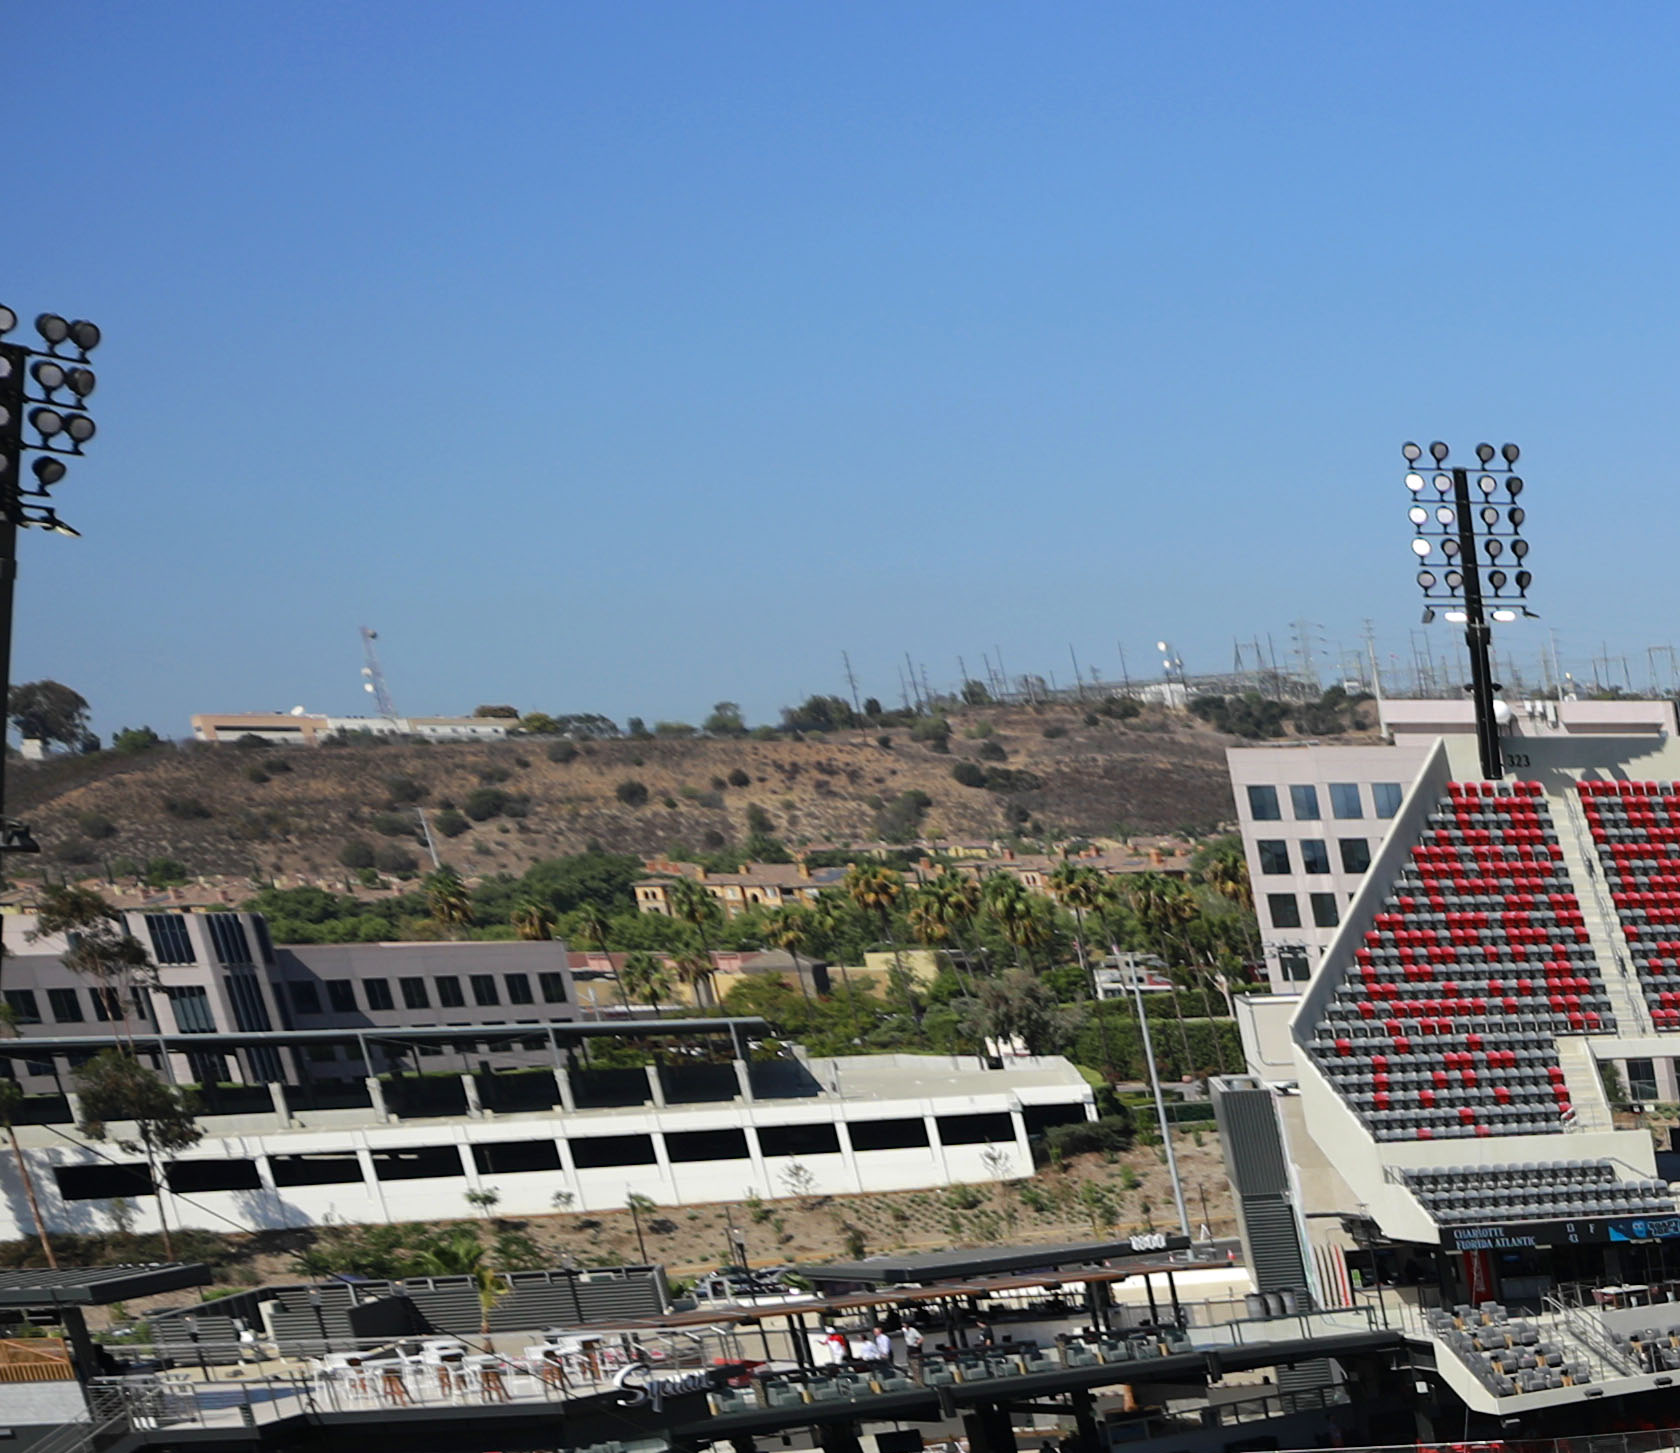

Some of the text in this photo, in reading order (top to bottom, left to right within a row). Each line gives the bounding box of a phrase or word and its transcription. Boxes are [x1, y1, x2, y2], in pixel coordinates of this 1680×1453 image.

[1507, 754, 1530, 767] 323
[1454, 1223, 1595, 1238] CHARLOTTE F
[1456, 1235, 1536, 1250] FLORIDA ATLANTIC
